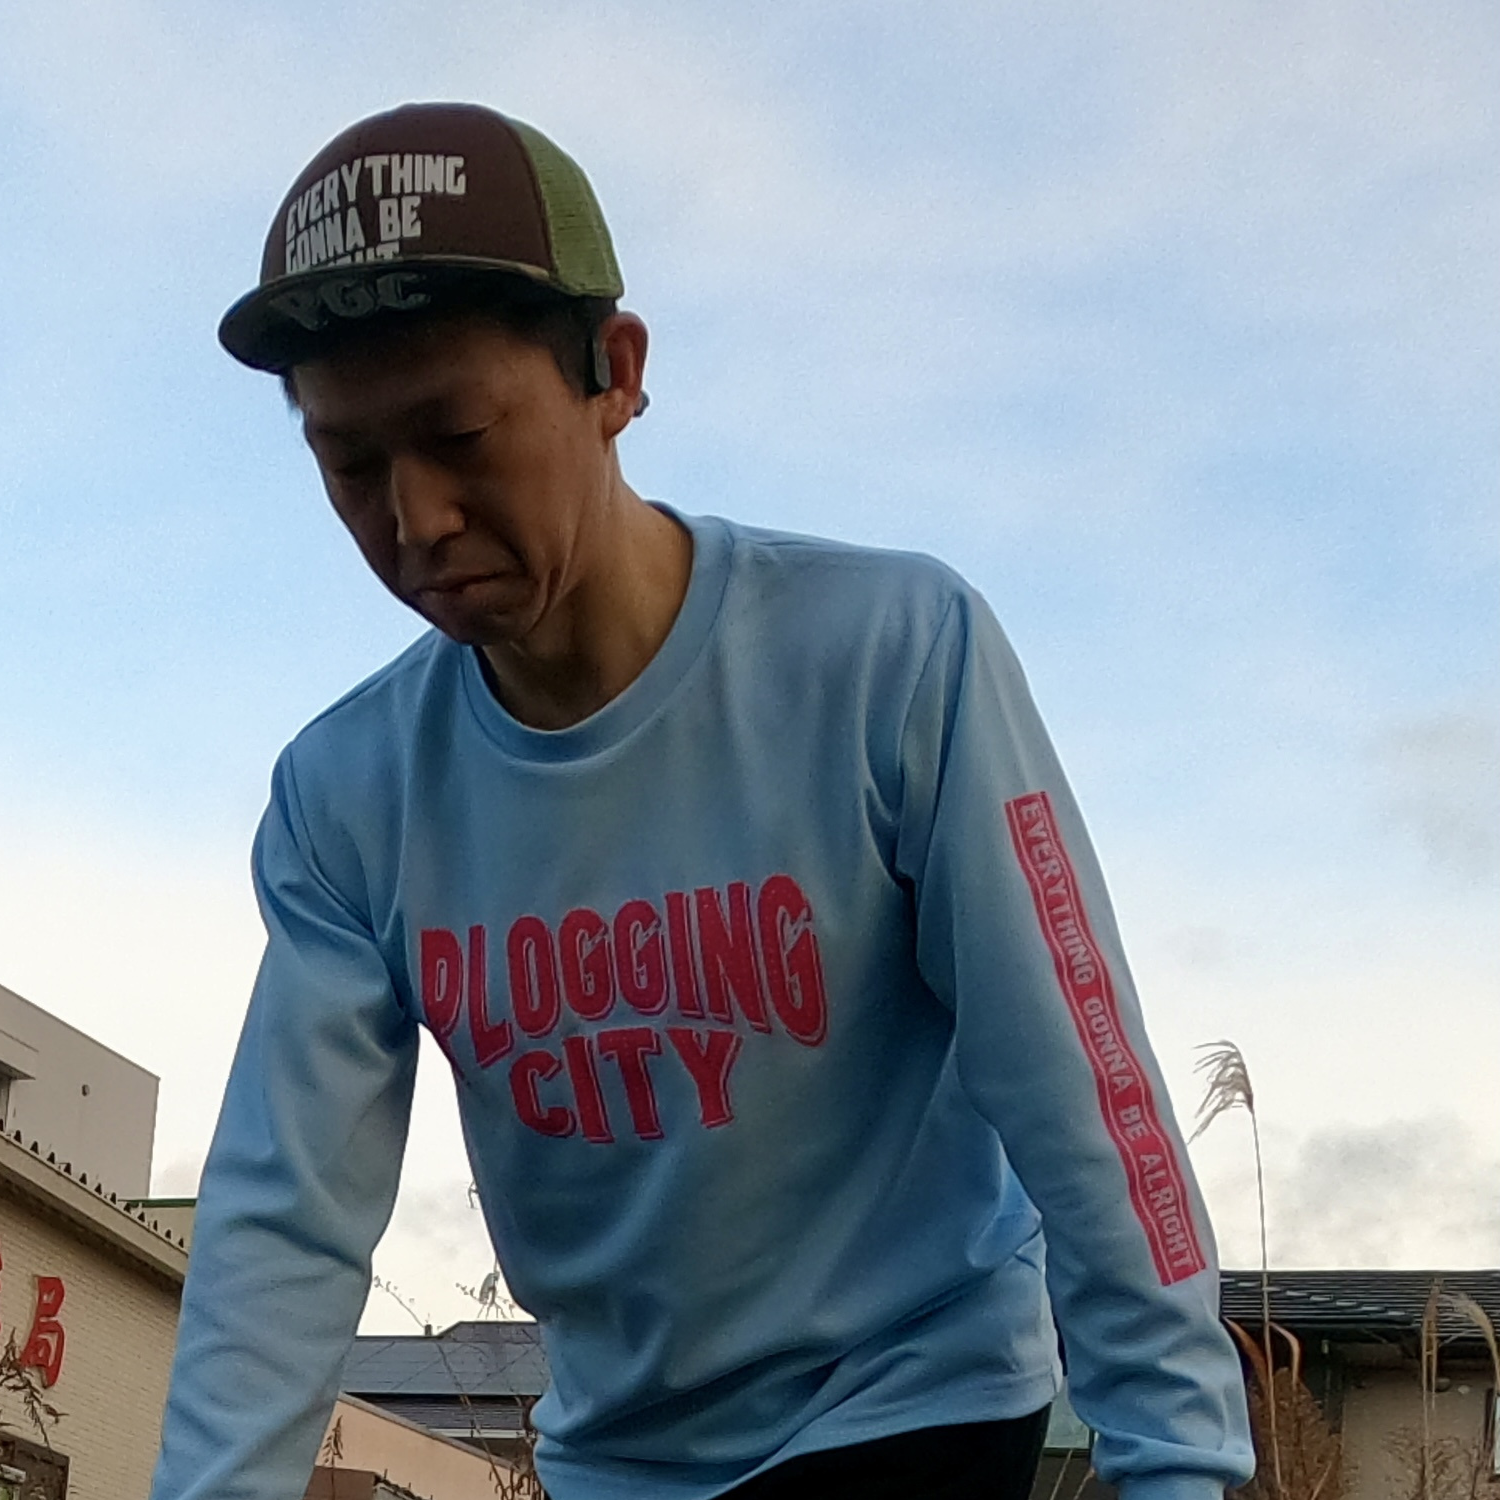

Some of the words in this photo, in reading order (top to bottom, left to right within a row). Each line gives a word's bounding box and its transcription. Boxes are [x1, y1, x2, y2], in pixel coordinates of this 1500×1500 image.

[286, 153, 467, 243] EVERYTHING
[286, 206, 366, 274] GONNA
[379, 195, 423, 242] BE
[420, 873, 828, 1080] PLOGGING
[1020, 801, 1097, 985] EVERYTHING
[1083, 996, 1135, 1094] GONNA
[1118, 1104, 1150, 1142] BE
[1139, 1152, 1194, 1269] ALRIGHT
[509, 1026, 744, 1144] CITY
